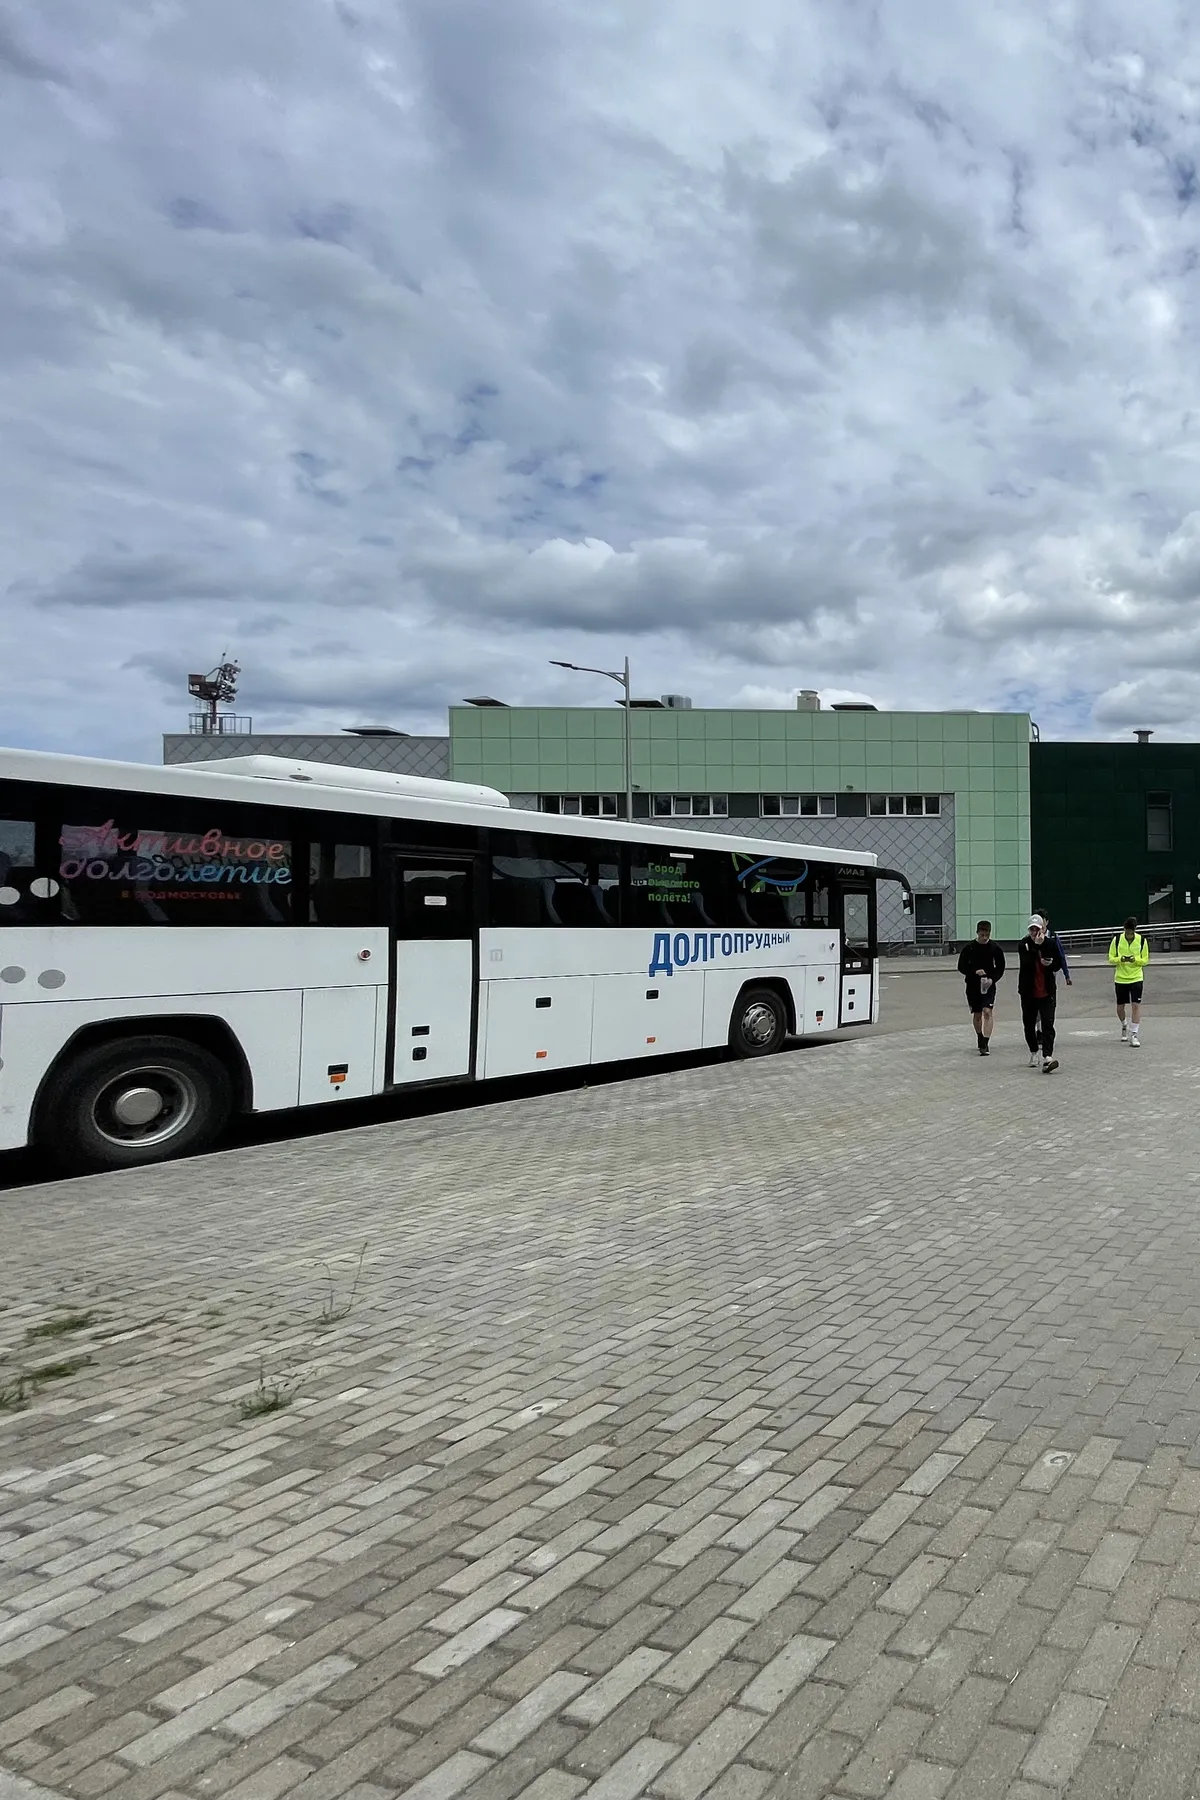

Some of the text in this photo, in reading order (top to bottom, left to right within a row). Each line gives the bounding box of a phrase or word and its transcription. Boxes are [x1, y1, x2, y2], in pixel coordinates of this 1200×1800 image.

[59, 819, 285, 860] Активное
[59, 857, 293, 884] долголетие
[647, 862, 683, 876] Город
[647, 892, 691, 903] полёта!
[648, 932, 790, 977] ДОЛГОПРУДНЫЙ
